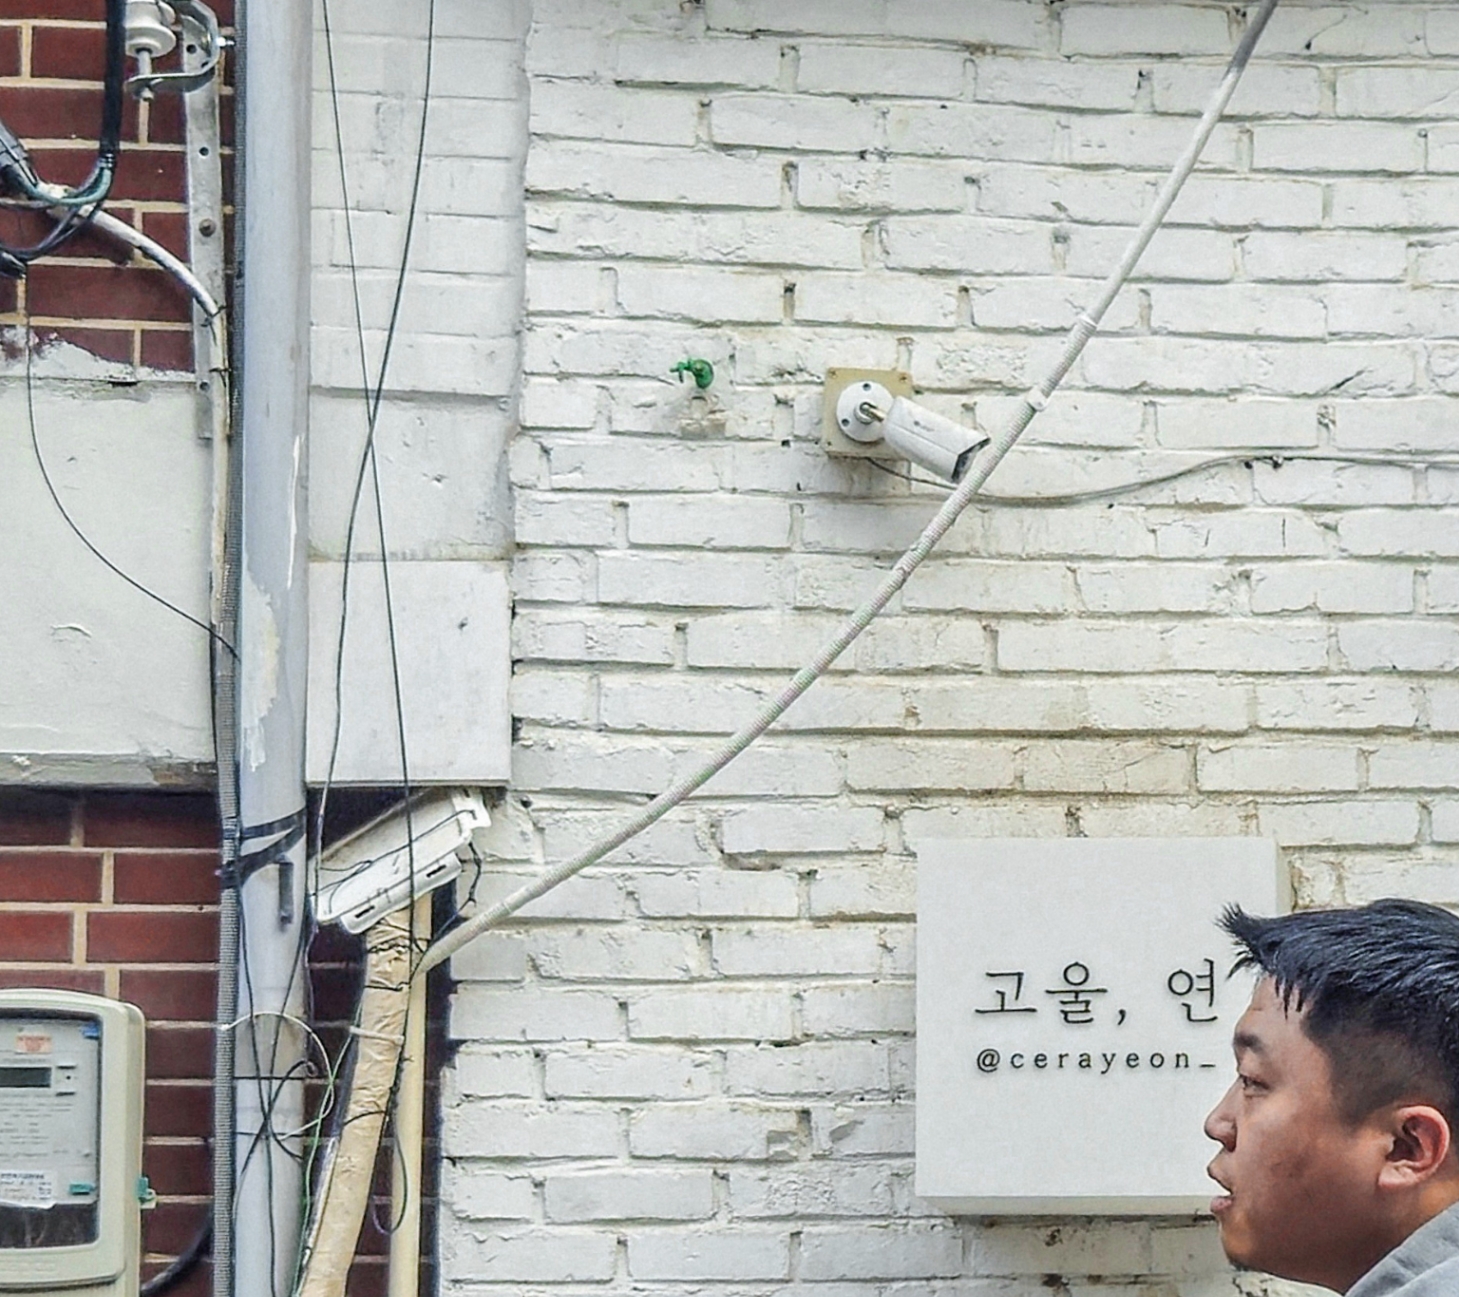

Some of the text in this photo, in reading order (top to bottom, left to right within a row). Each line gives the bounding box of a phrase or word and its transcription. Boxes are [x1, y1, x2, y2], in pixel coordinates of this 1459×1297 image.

[974, 957, 1219, 1026] 고울, 연
[975, 1048, 1217, 1075] @cerayeon_
